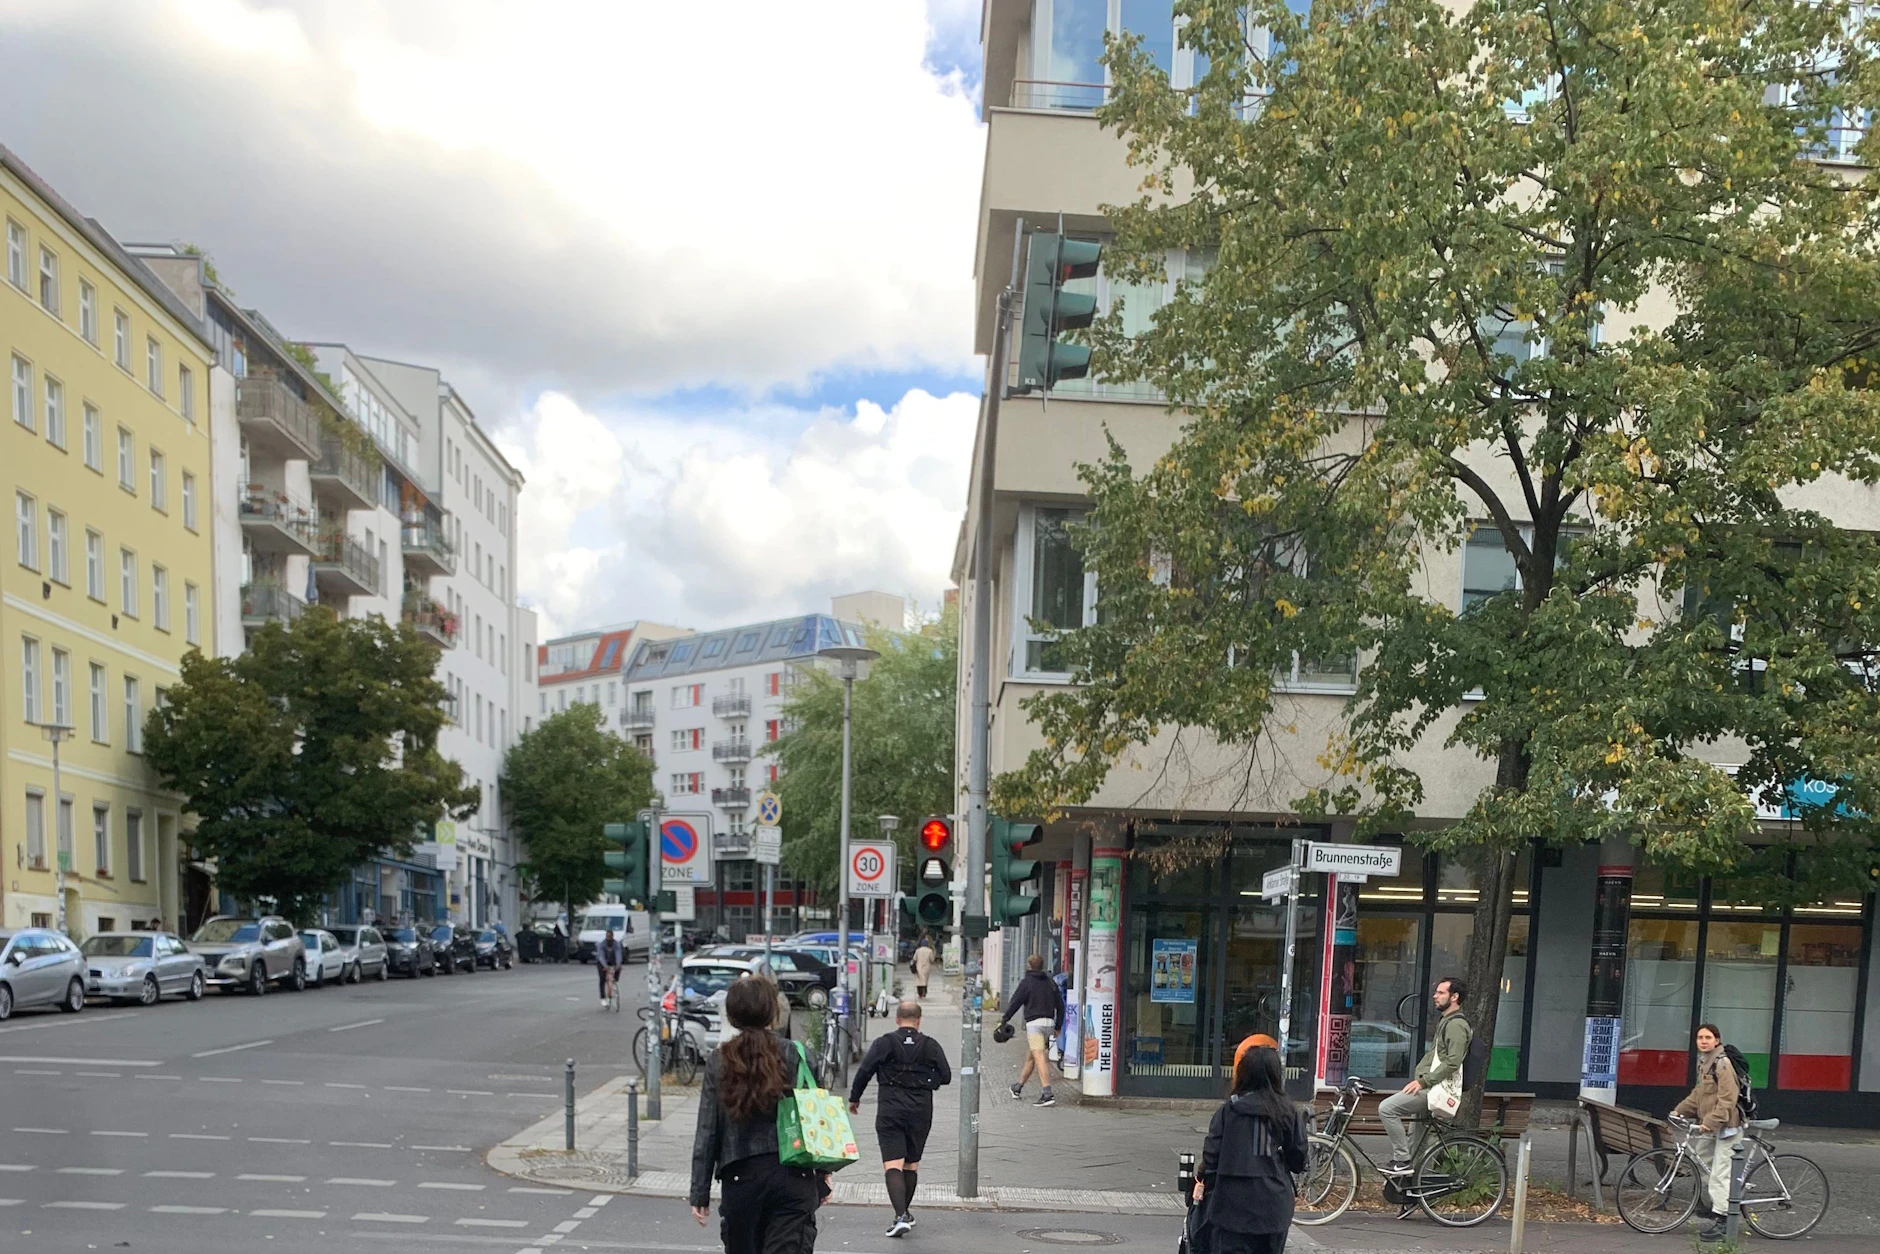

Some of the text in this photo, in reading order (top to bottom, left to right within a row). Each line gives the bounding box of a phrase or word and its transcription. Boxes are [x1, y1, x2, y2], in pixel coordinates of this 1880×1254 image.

[860, 857, 878, 872] 30
[1315, 849, 1393, 869] Brunnenstraße
[662, 867, 694, 879] ZONE
[856, 883, 880, 892] ZONE
[1100, 1003, 1113, 1072] THE HUNGER
